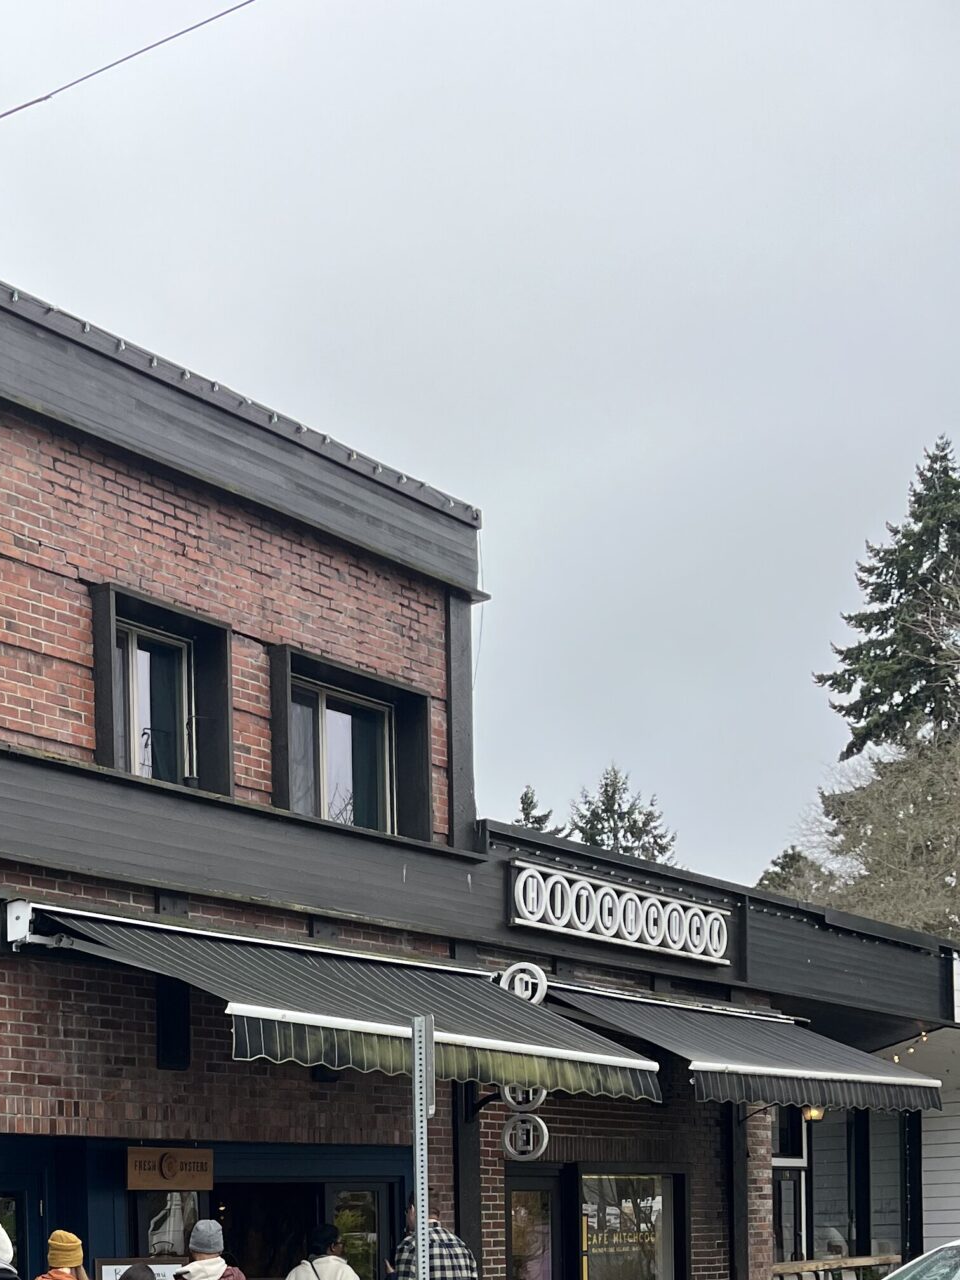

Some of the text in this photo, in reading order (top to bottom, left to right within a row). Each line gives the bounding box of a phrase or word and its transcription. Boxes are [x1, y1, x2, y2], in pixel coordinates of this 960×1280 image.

[519, 872, 725, 954] HITCHCOCK
[179, 1160, 208, 1173] OYSTERS
[613, 1231, 656, 1245] HITCHCOC
